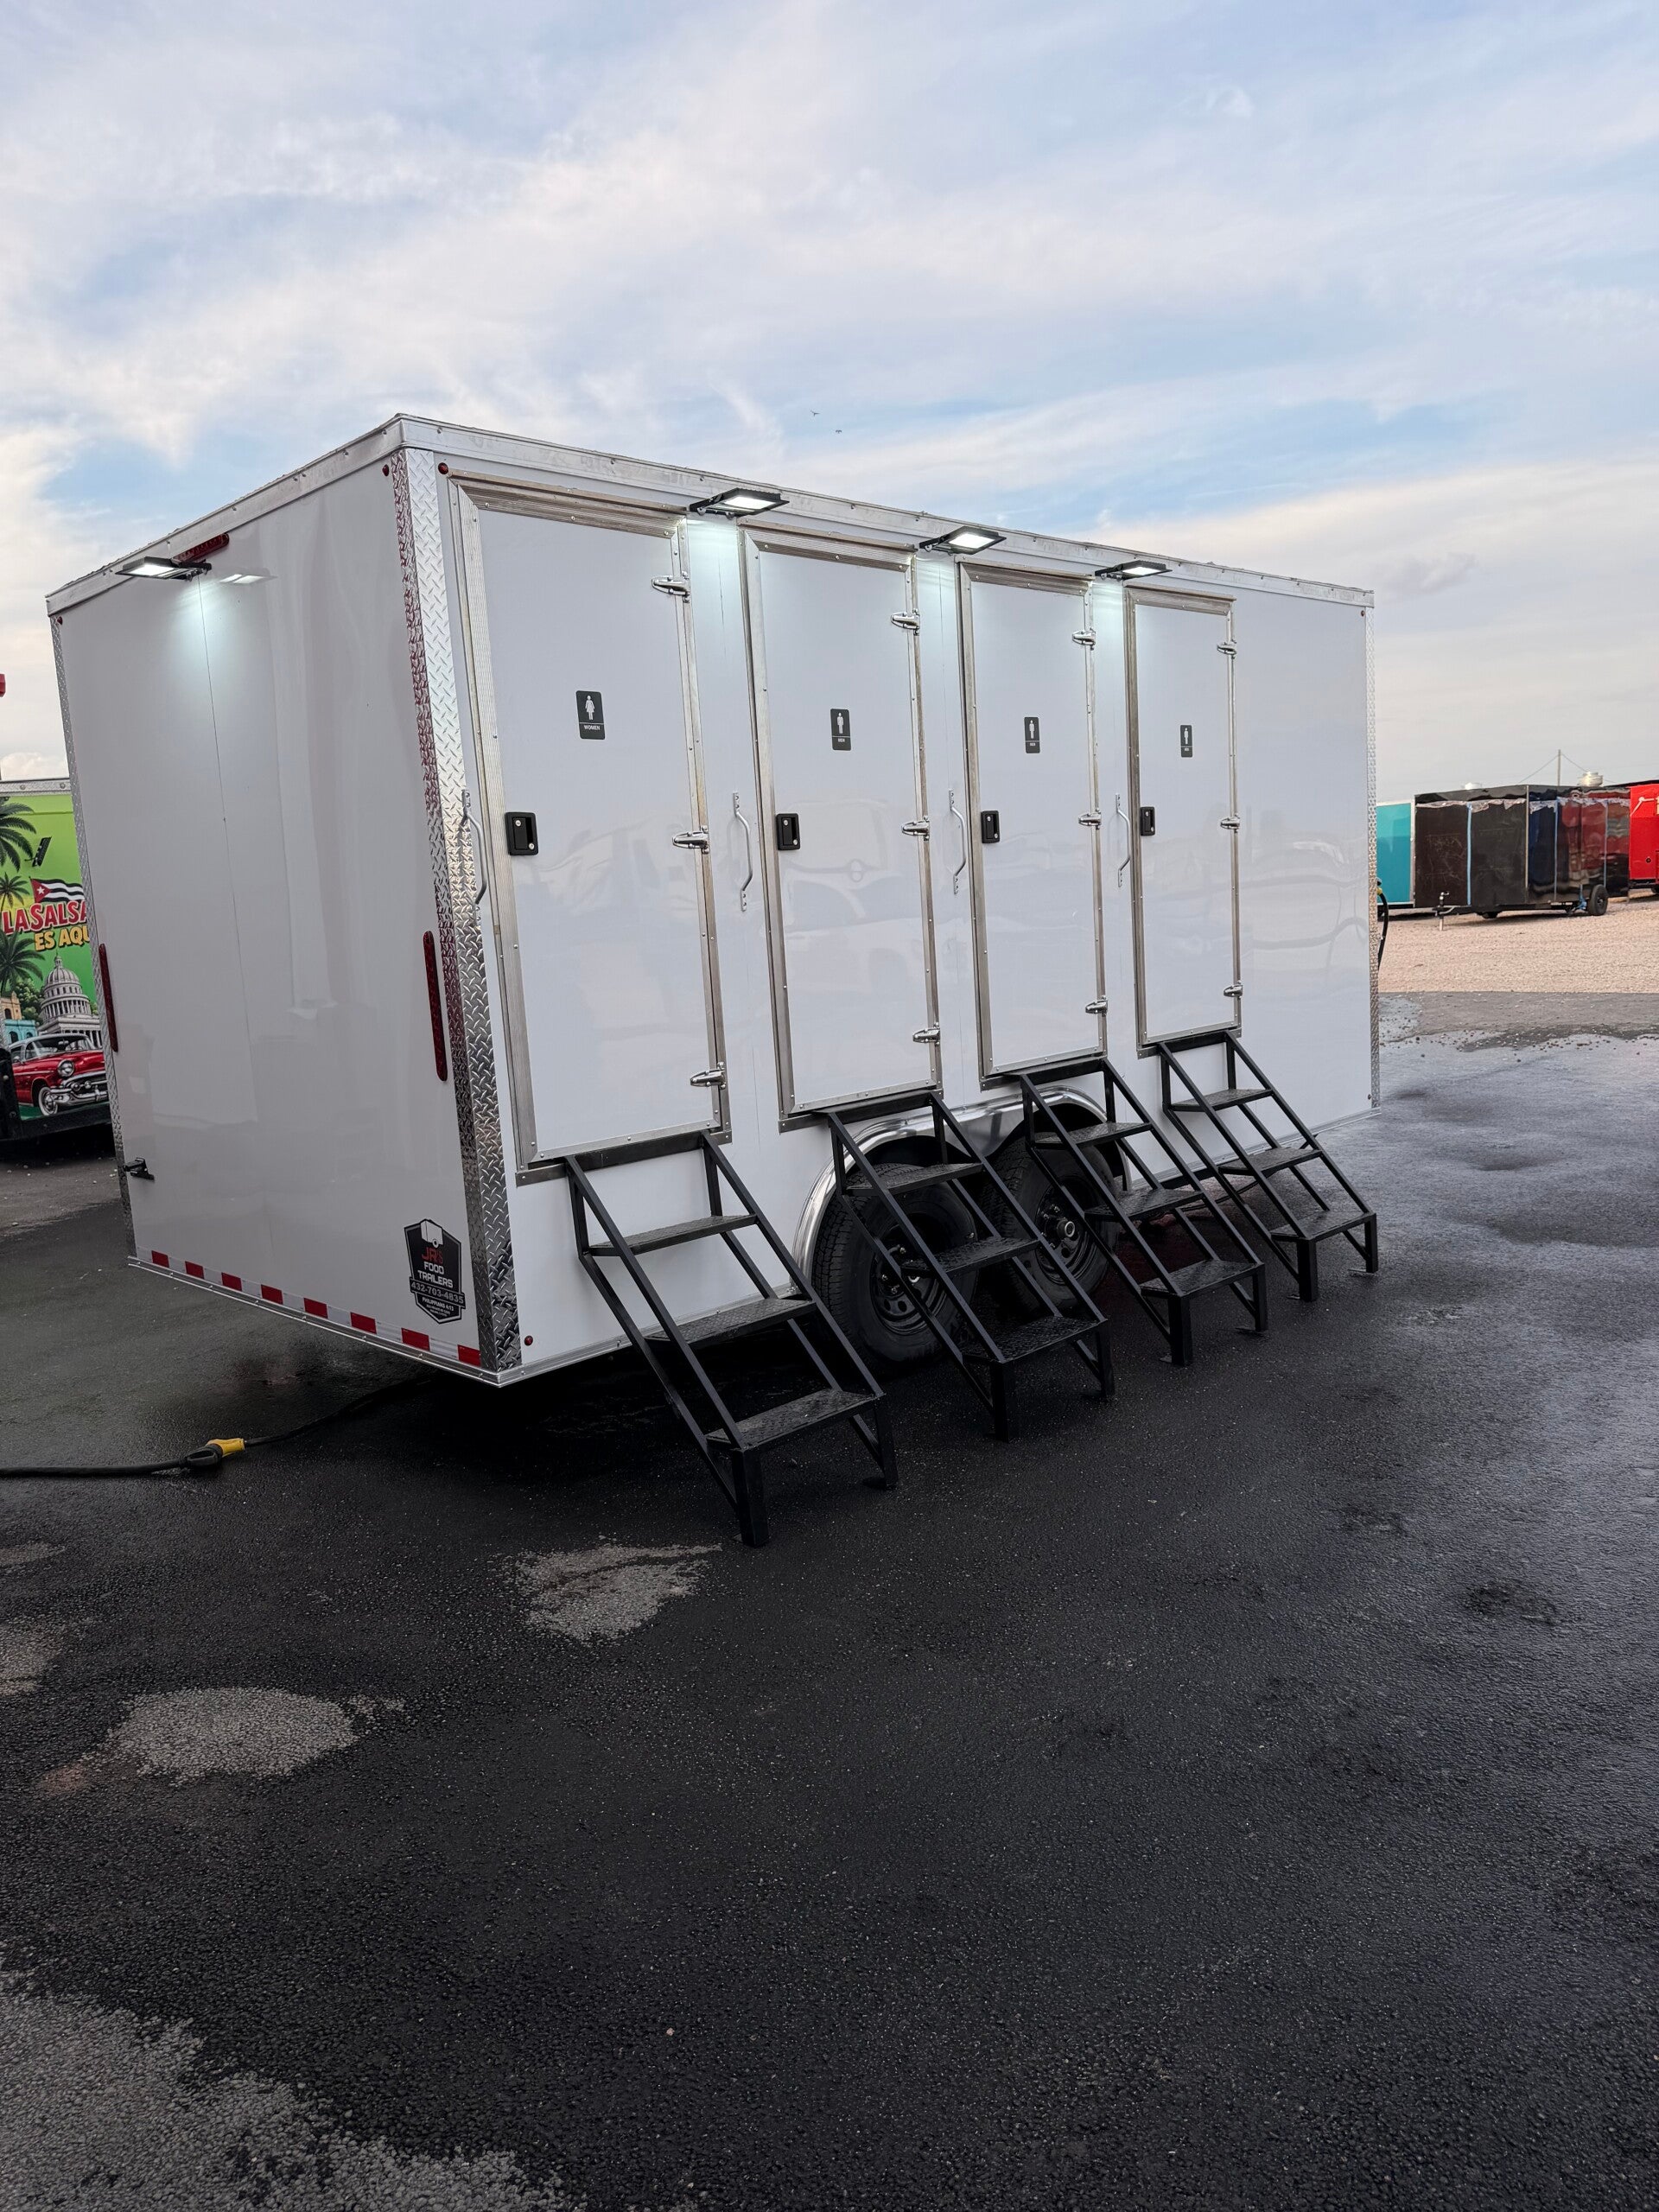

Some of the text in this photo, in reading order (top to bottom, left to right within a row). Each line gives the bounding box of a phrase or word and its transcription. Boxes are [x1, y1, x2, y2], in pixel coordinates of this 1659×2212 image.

[35, 931, 55, 951] ES
[423, 1262, 444, 1274] FOOD
[417, 1270, 454, 1288] TRAILERS
[411, 1281, 464, 1304] 432-703-4835
